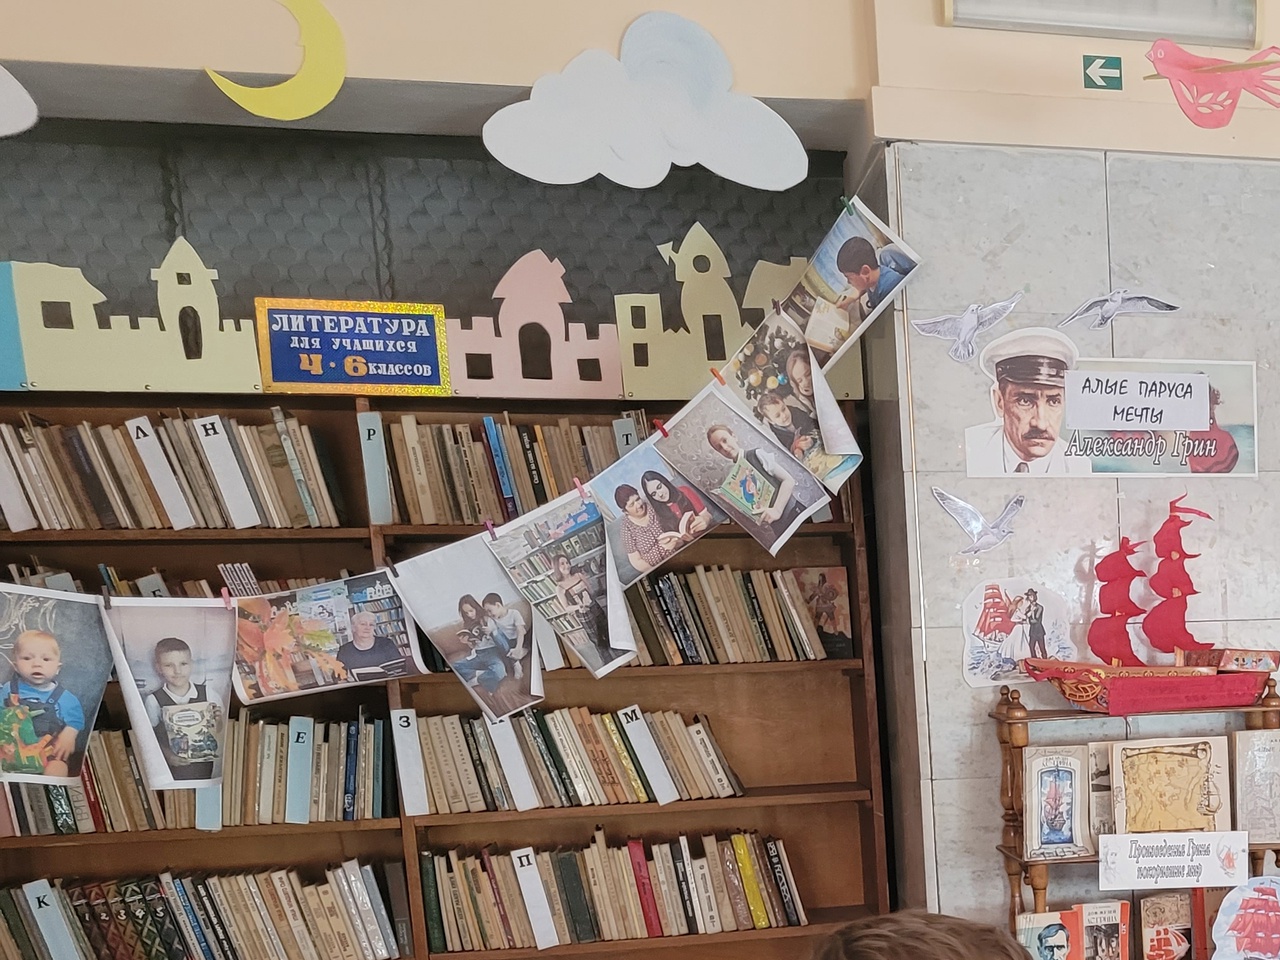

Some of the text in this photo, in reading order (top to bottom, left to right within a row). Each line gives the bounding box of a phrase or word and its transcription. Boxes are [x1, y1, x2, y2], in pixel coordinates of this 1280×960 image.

[271, 314, 430, 337] ЛИТЕРАТУРА
[290, 336, 417, 353] ДЛЯ УЧАЩИХСЯ
[368, 363, 432, 377] КЛАССОВ
[1081, 376, 1193, 399] АЛЫЕ ПАРУСА
[1112, 405, 1163, 424] МЕЧТЫ
[200, 421, 220, 437] Н
[365, 428, 376, 441] Р
[621, 433, 632, 446] Т
[1065, 429, 1218, 466] Александр Грин
[398, 715, 411, 728] З
[622, 708, 640, 723] М
[294, 730, 307, 744] Е
[1187, 838, 1211, 862] Грина
[516, 854, 532, 868] П
[34, 895, 51, 909] К
[85, 913, 90, 921] 1
[100, 912, 110, 920] 2
[117, 910, 127, 920] 3
[135, 908, 145, 918] 4
[156, 907, 164, 917] 5
